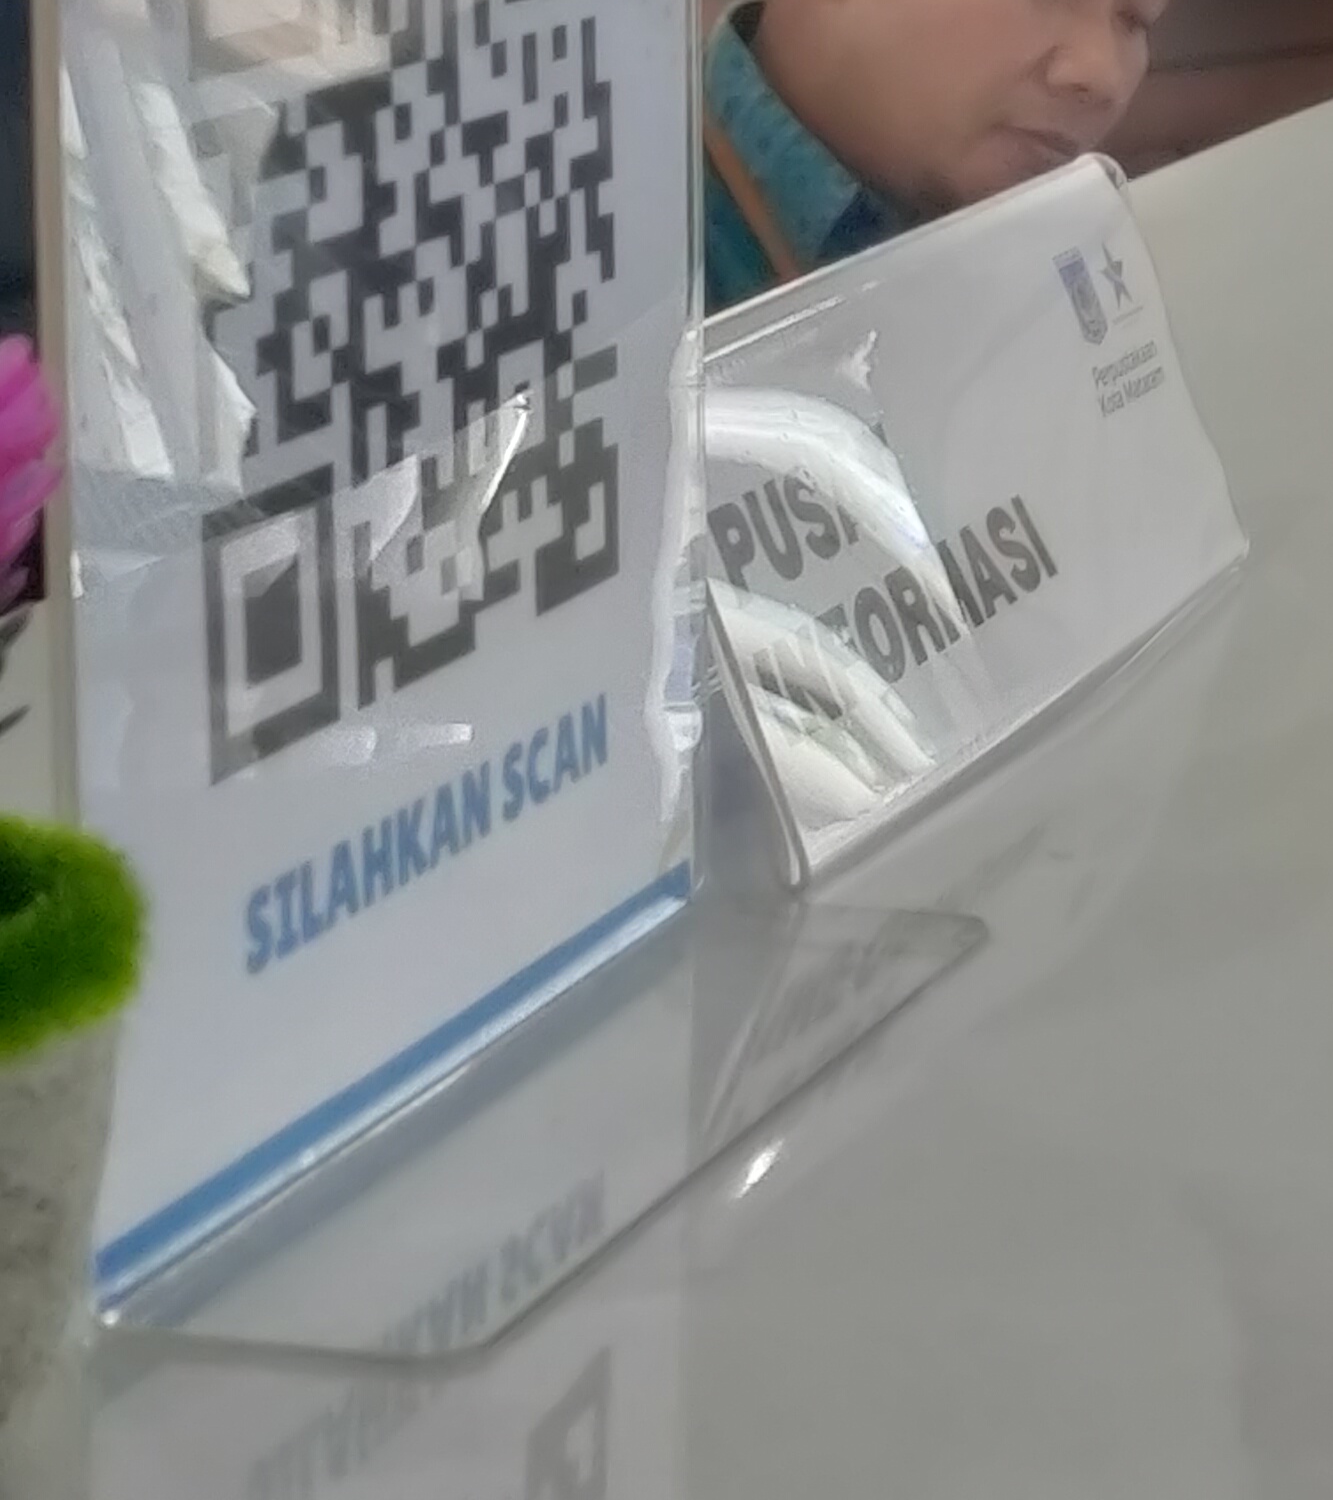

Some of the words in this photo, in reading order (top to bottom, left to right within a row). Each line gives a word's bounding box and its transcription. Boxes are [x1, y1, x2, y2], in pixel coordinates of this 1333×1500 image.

[706, 468, 860, 591] PUS
[245, 762, 493, 975] SILAHKAN
[502, 693, 609, 821] SCAN
